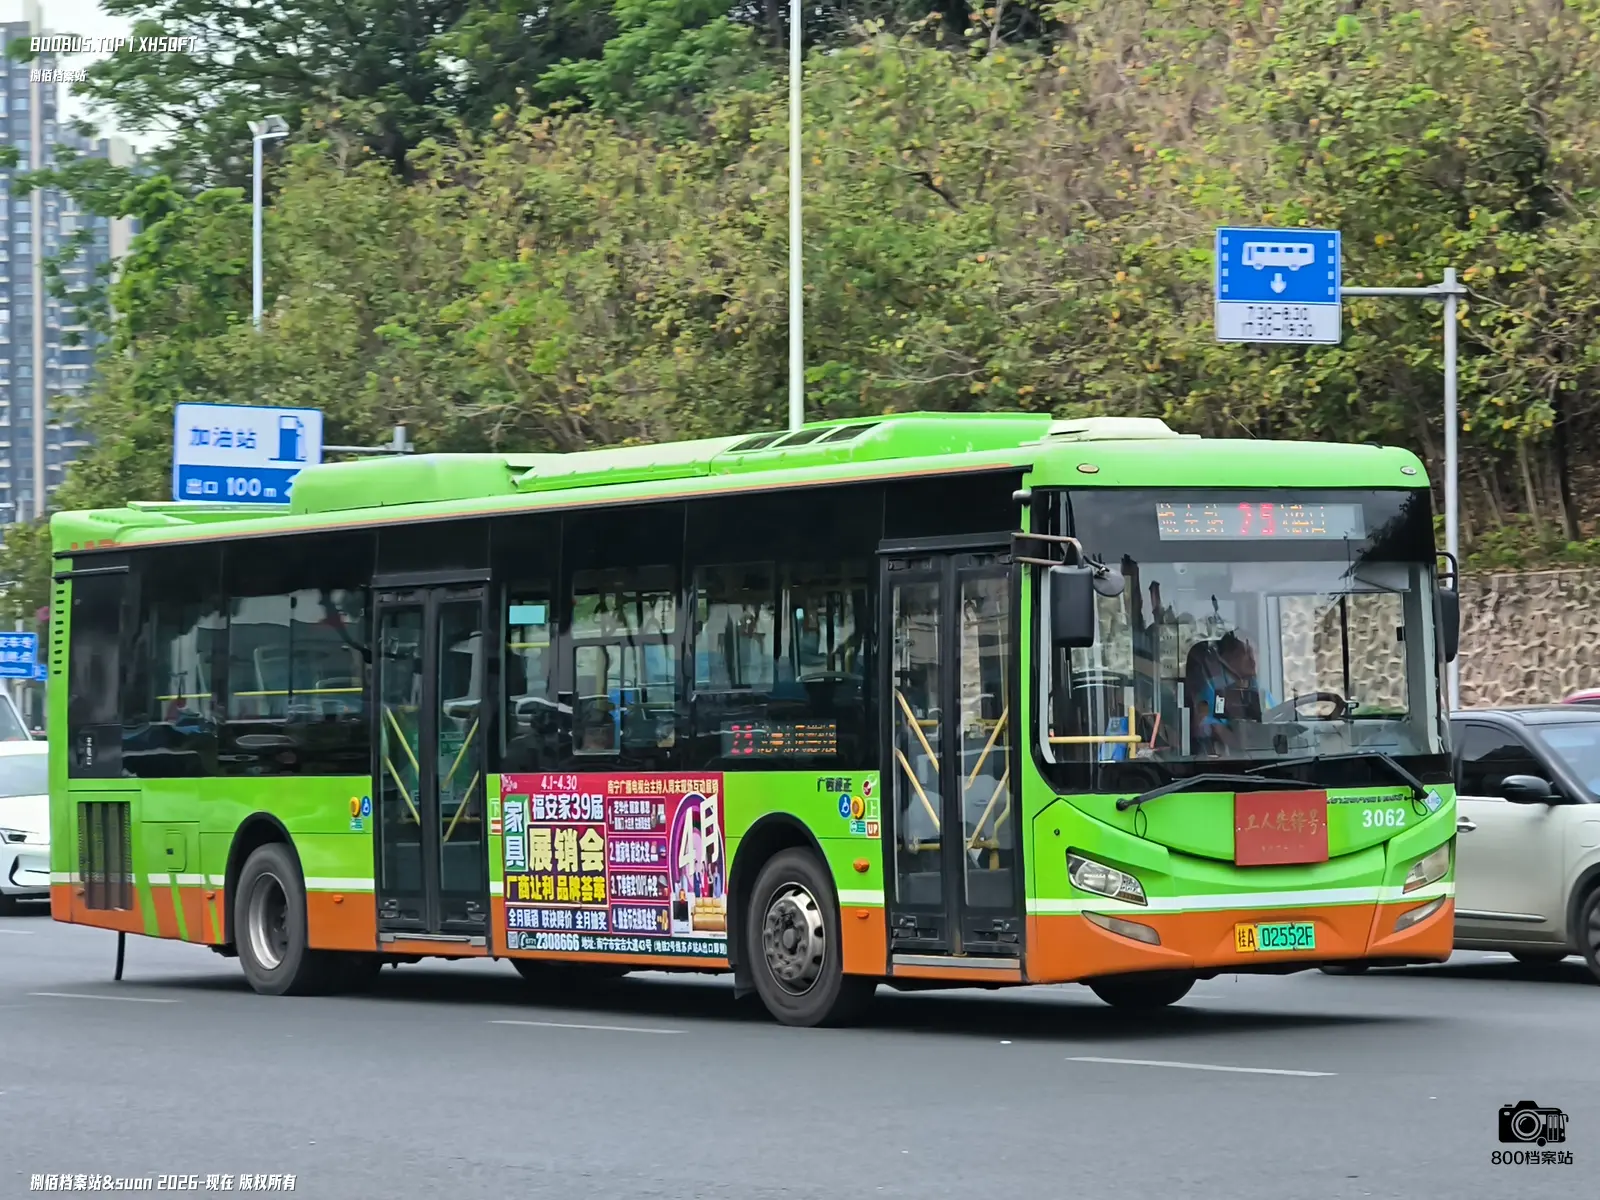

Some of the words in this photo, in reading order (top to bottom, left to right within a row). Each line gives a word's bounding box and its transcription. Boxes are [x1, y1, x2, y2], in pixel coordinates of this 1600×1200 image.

[189, 425, 257, 450] 加油站
[186, 478, 218, 495] 出口
[226, 477, 262, 497] 100
[263, 487, 277, 497] m
[541, 775, 578, 791] 4.1-4.30
[532, 793, 605, 821] 福安家39届
[1362, 807, 1406, 828] 3062
[503, 800, 525, 867] 家具
[867, 823, 878, 835] UP
[529, 828, 605, 873] 展销会
[506, 875, 555, 901] 厂商让利
[556, 875, 606, 902] 品牌荟萃
[536, 932, 580, 951] 2308666
[1238, 928, 1256, 948] 桂A
[1261, 926, 1314, 947] 02552F
